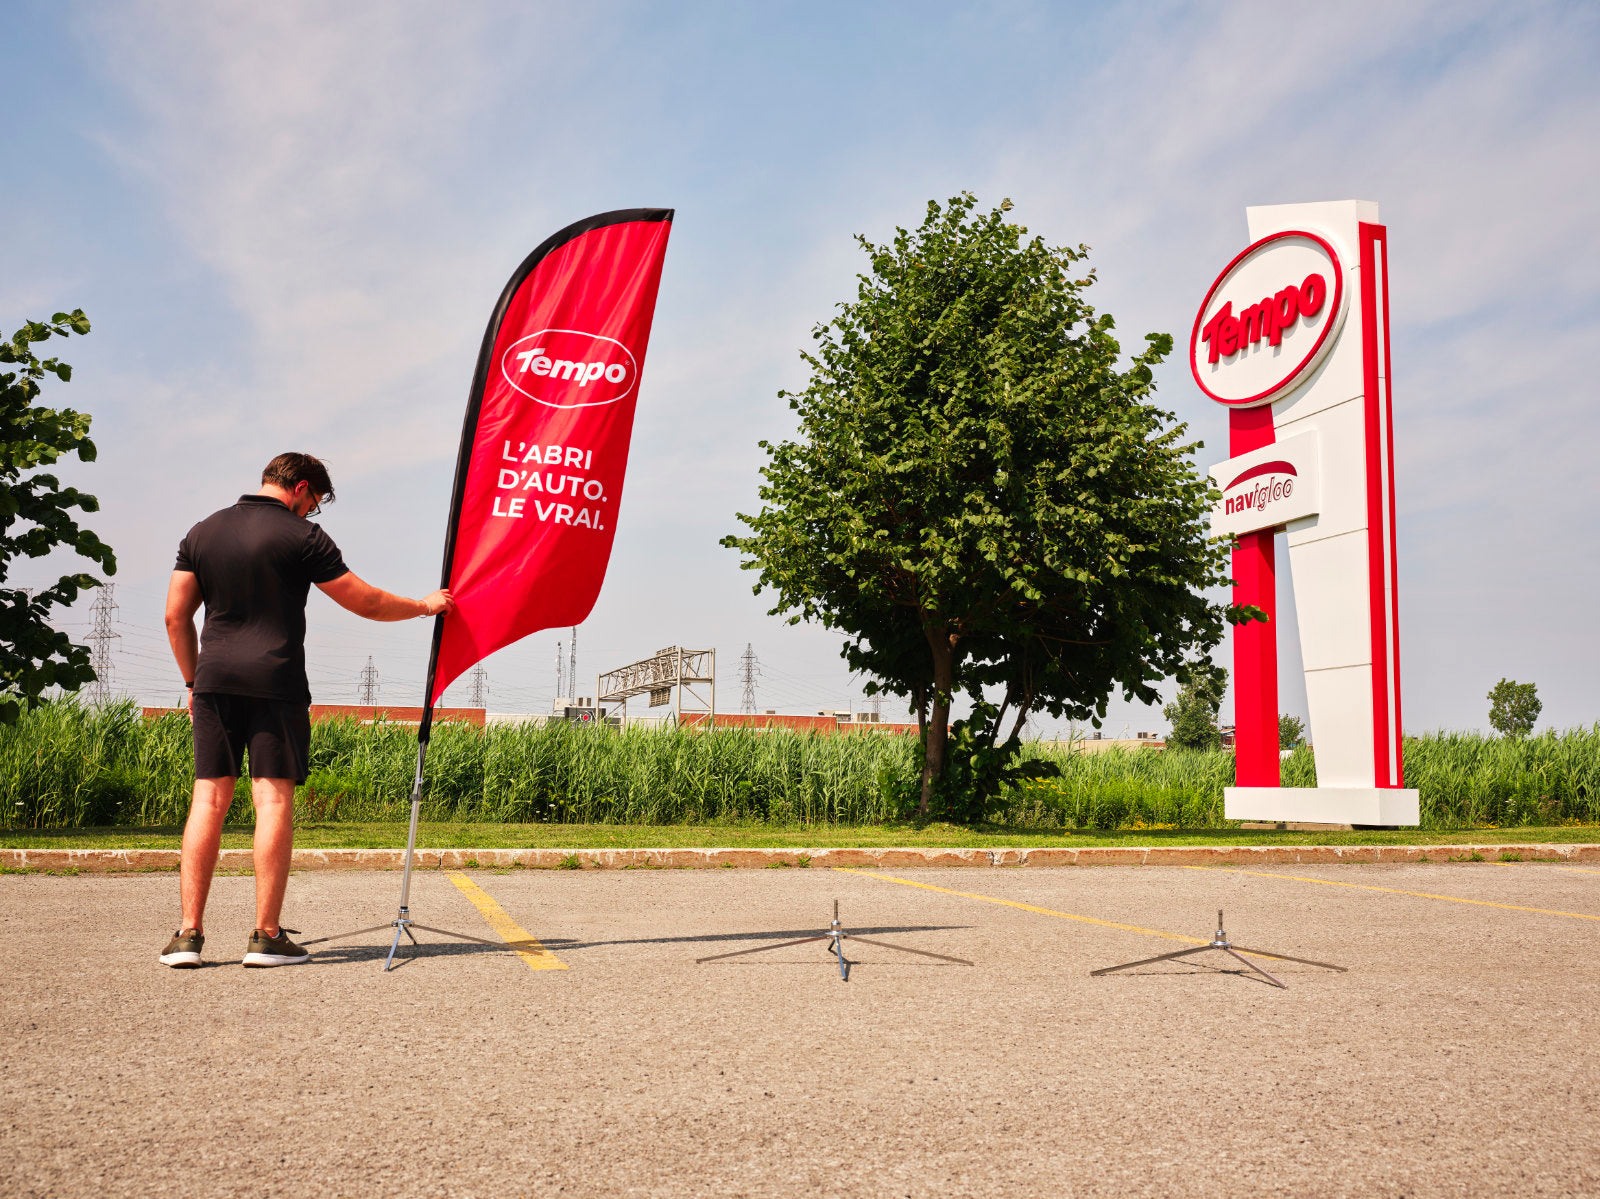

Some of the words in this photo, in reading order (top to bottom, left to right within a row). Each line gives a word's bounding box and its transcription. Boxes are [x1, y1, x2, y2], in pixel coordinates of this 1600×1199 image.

[1202, 273, 1327, 364] Tempo
[516, 348, 627, 387] Tempo
[502, 440, 593, 470] L’ABRI
[497, 468, 608, 502] D’AUTO.
[1225, 476, 1294, 515] navigloo
[491, 496, 526, 519] LE
[534, 499, 605, 531] VRAI.
